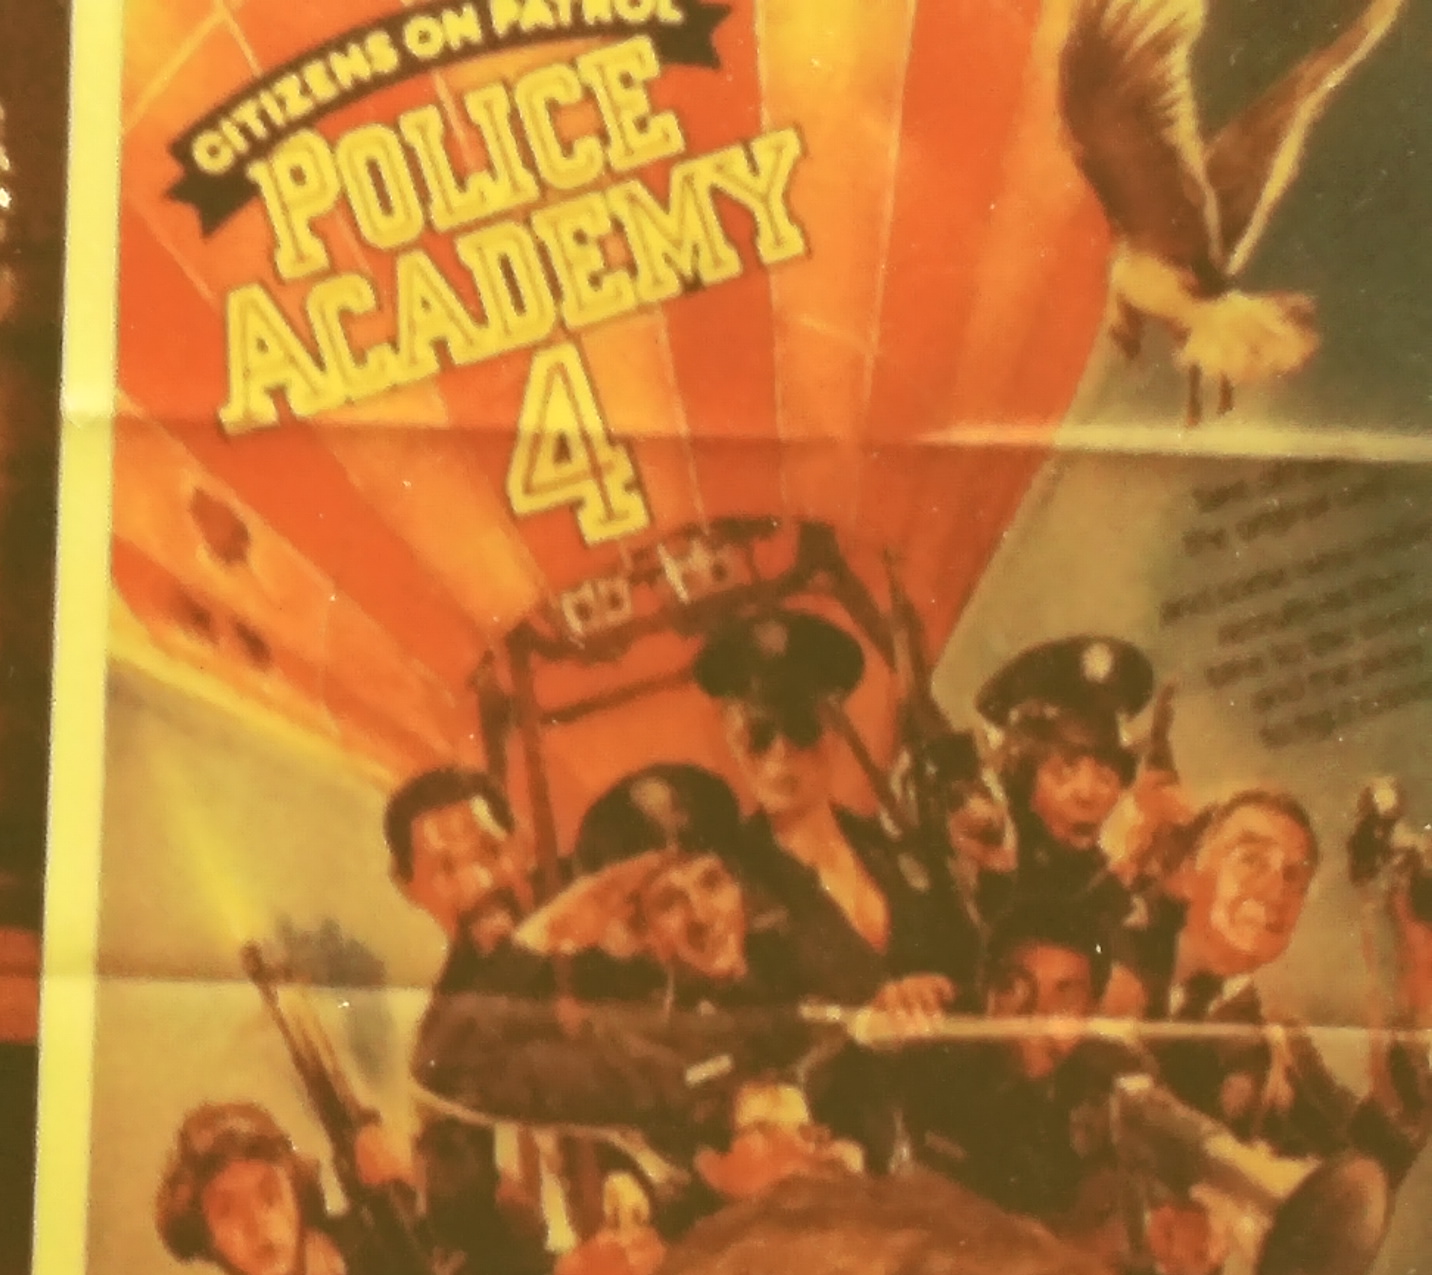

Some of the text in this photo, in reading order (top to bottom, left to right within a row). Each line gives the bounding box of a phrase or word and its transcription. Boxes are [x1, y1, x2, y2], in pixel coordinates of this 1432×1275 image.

[192, 30, 399, 174] CITIZENS
[404, 3, 483, 59] ON
[247, 35, 685, 280] POLICE
[217, 127, 808, 434] ACADEMY
[505, 340, 651, 546] 4
